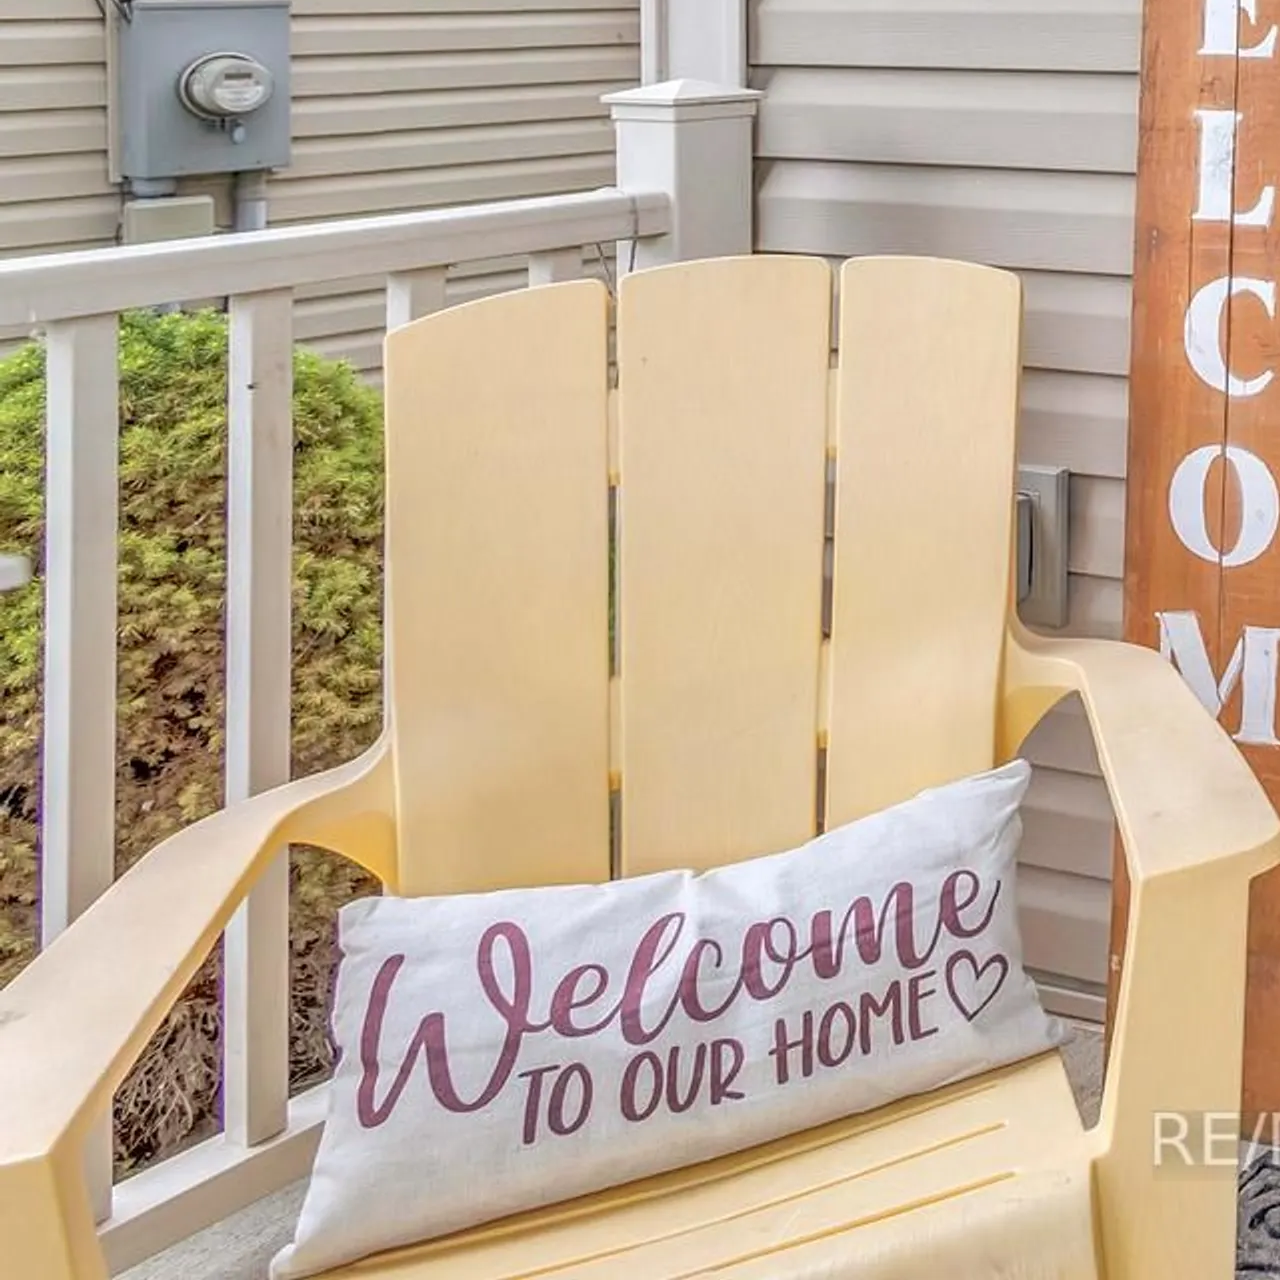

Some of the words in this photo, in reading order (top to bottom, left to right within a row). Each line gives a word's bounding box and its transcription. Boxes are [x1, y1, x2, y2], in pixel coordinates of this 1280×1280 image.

[356, 867, 1002, 1129] Welcome
[518, 1061, 593, 1146] TO
[619, 1037, 746, 1123] OUR
[768, 968, 938, 1086] HOME
